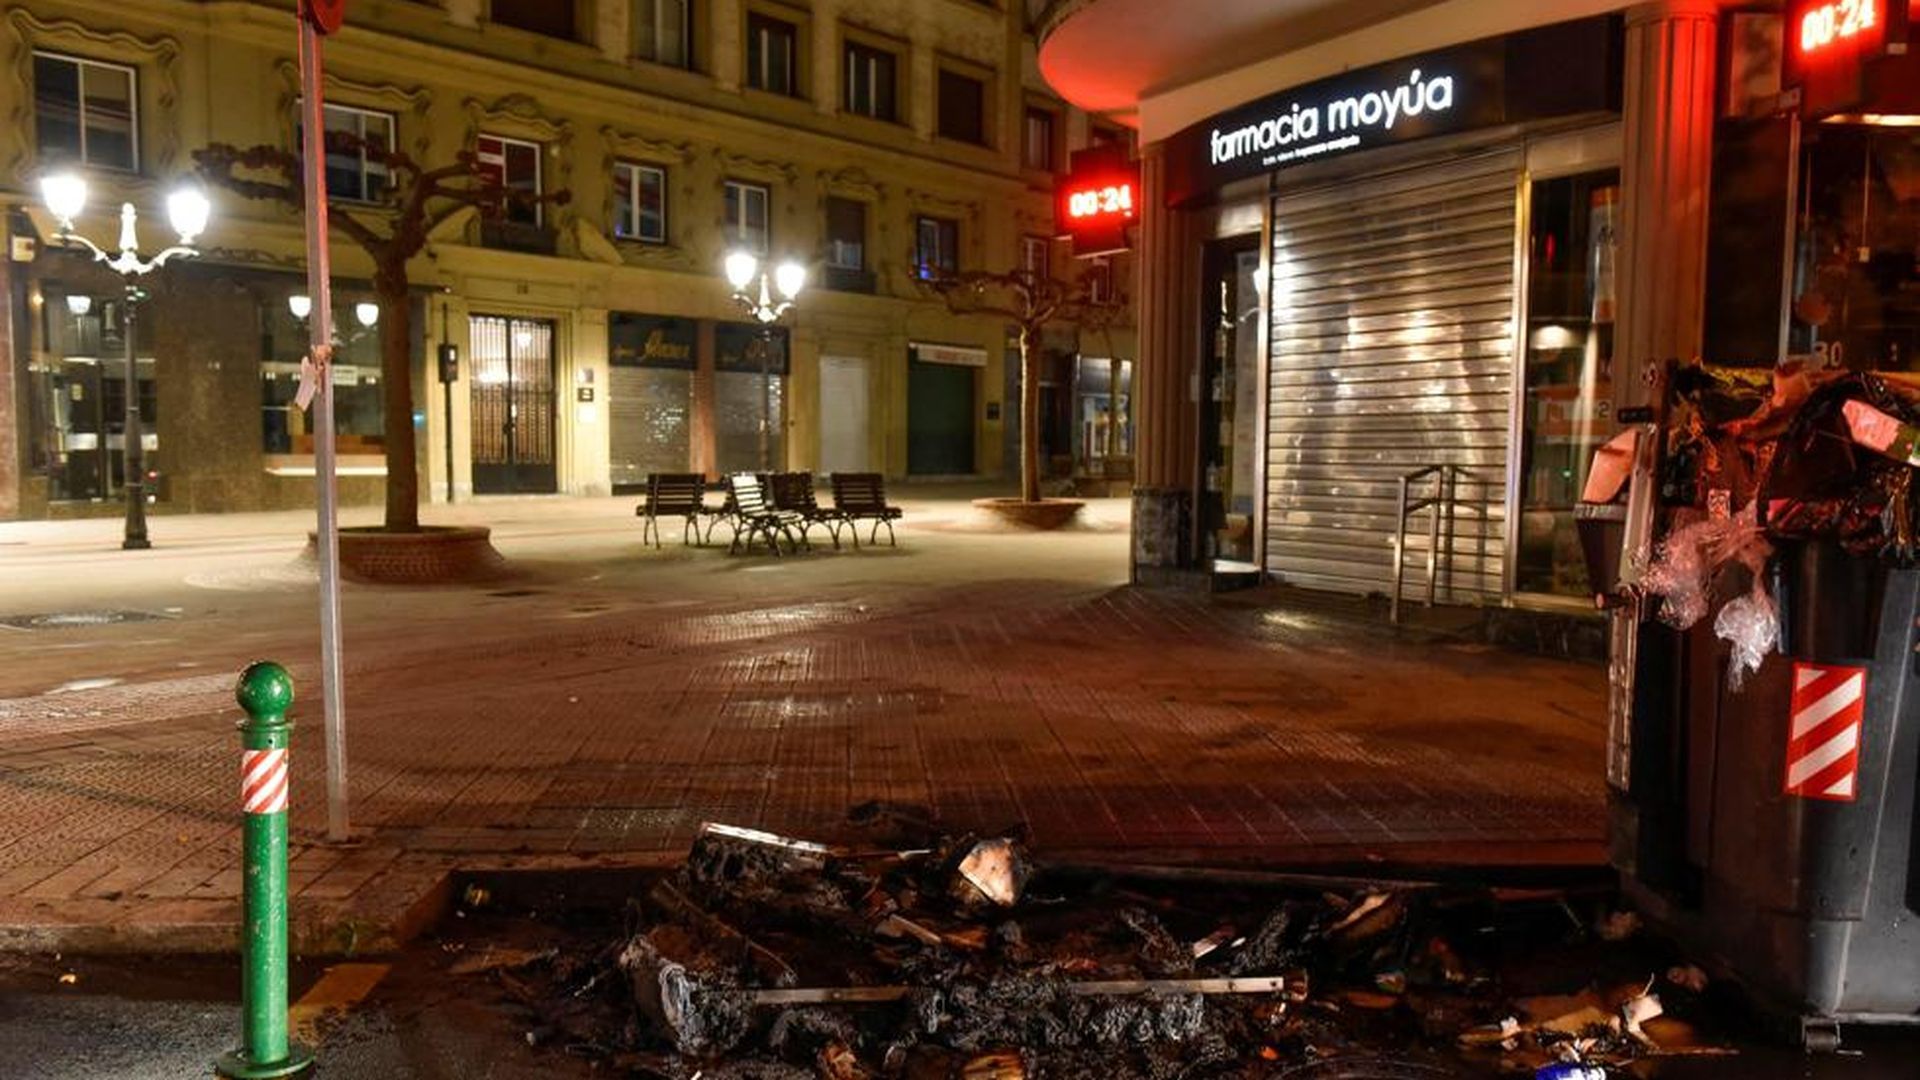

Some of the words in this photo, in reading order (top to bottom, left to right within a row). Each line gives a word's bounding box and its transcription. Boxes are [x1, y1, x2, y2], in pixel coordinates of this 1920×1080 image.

[1801, 0, 1875, 51] 00:24
[1211, 103, 1319, 164] farmacia
[1328, 68, 1452, 129] moyúa
[1069, 183, 1132, 217] 00:24
